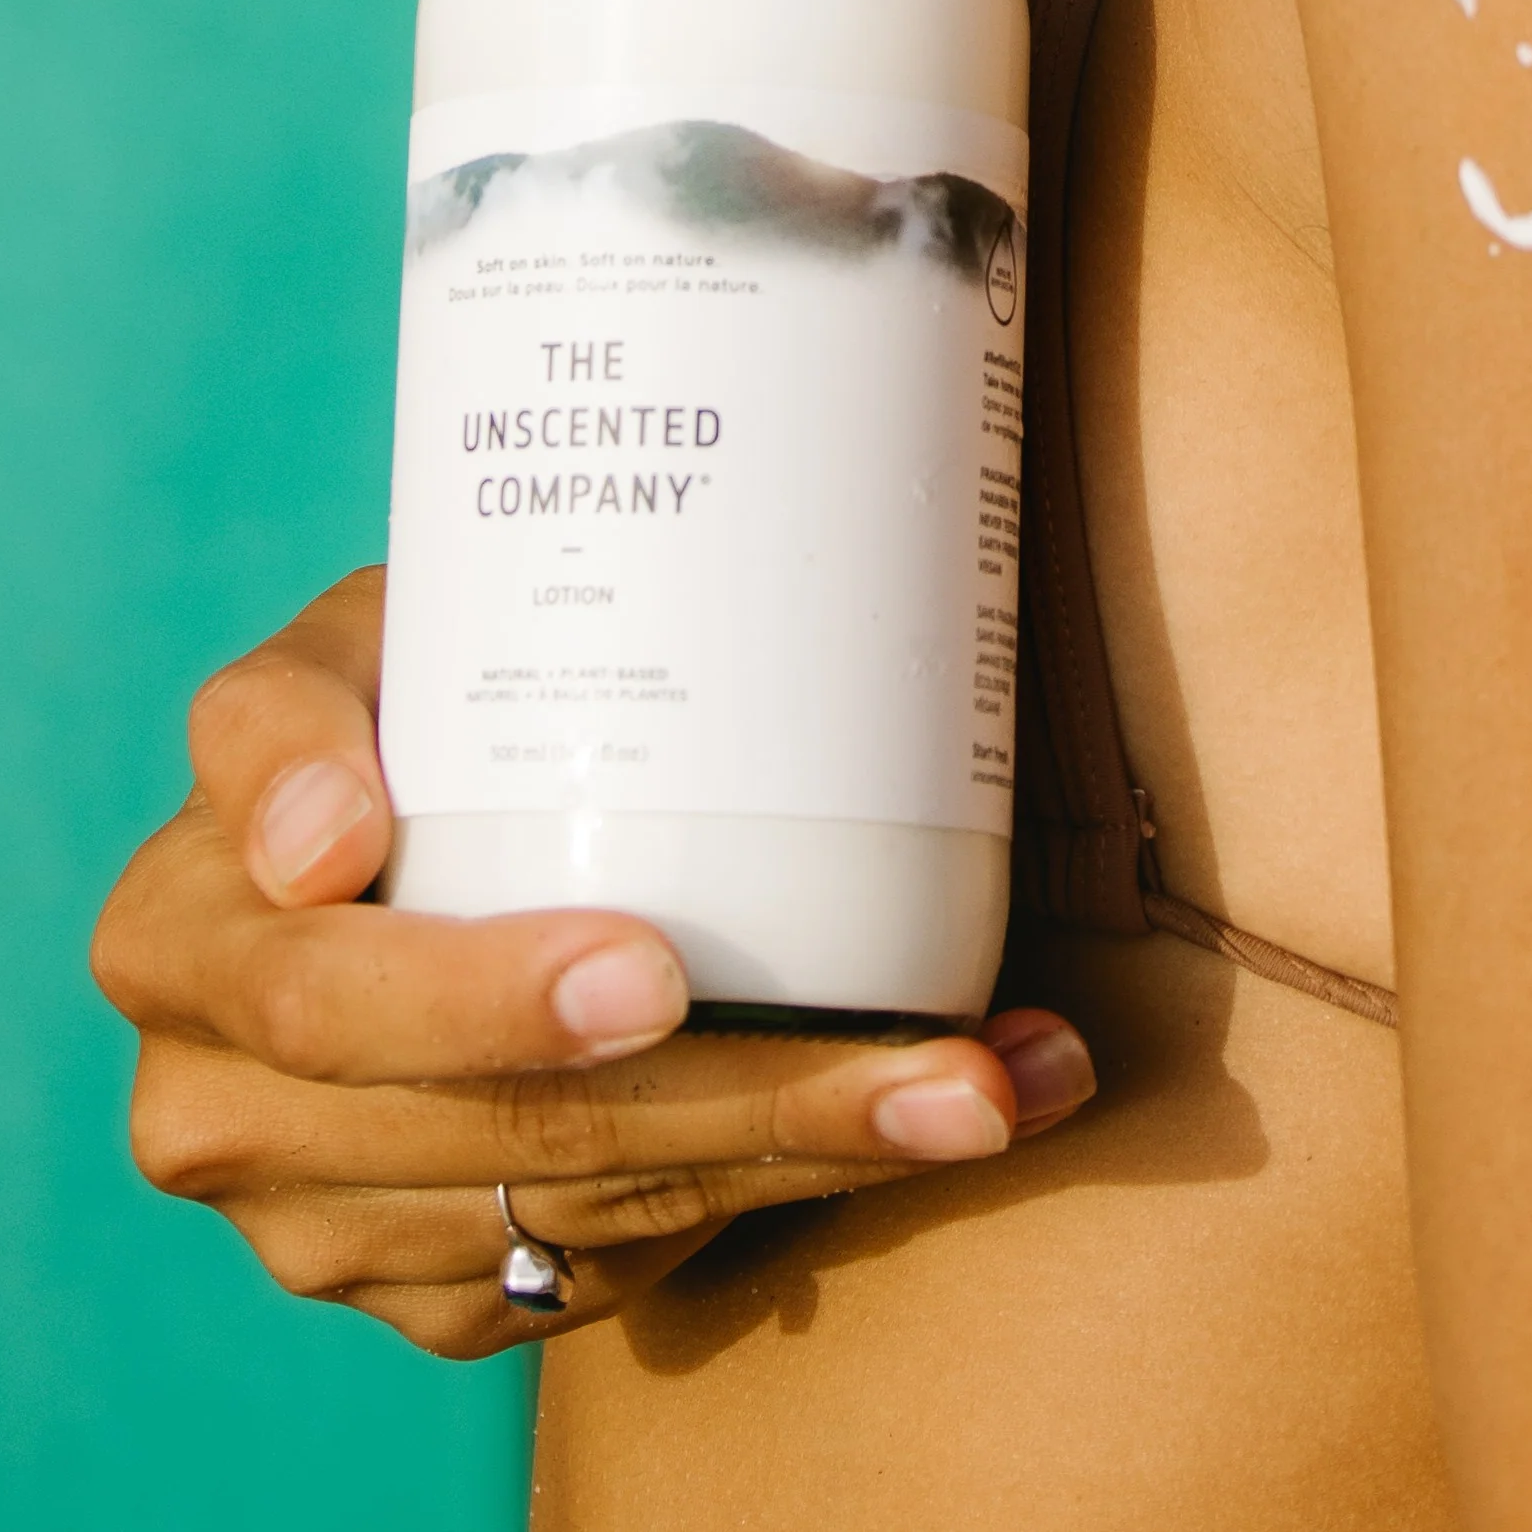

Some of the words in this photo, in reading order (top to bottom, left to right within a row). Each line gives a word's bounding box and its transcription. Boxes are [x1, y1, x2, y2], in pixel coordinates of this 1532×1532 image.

[476, 258, 504, 275] Soft
[509, 257, 528, 271] on
[580, 251, 615, 267] Soft
[623, 253, 646, 267] on
[626, 279, 669, 296] pour
[675, 278, 691, 292] la
[540, 340, 625, 383] THE
[462, 406, 722, 453] UNSCENTED
[532, 585, 615, 607] LOTION
[481, 667, 540, 682] NATURAL
[618, 687, 688, 703] PLANTES
